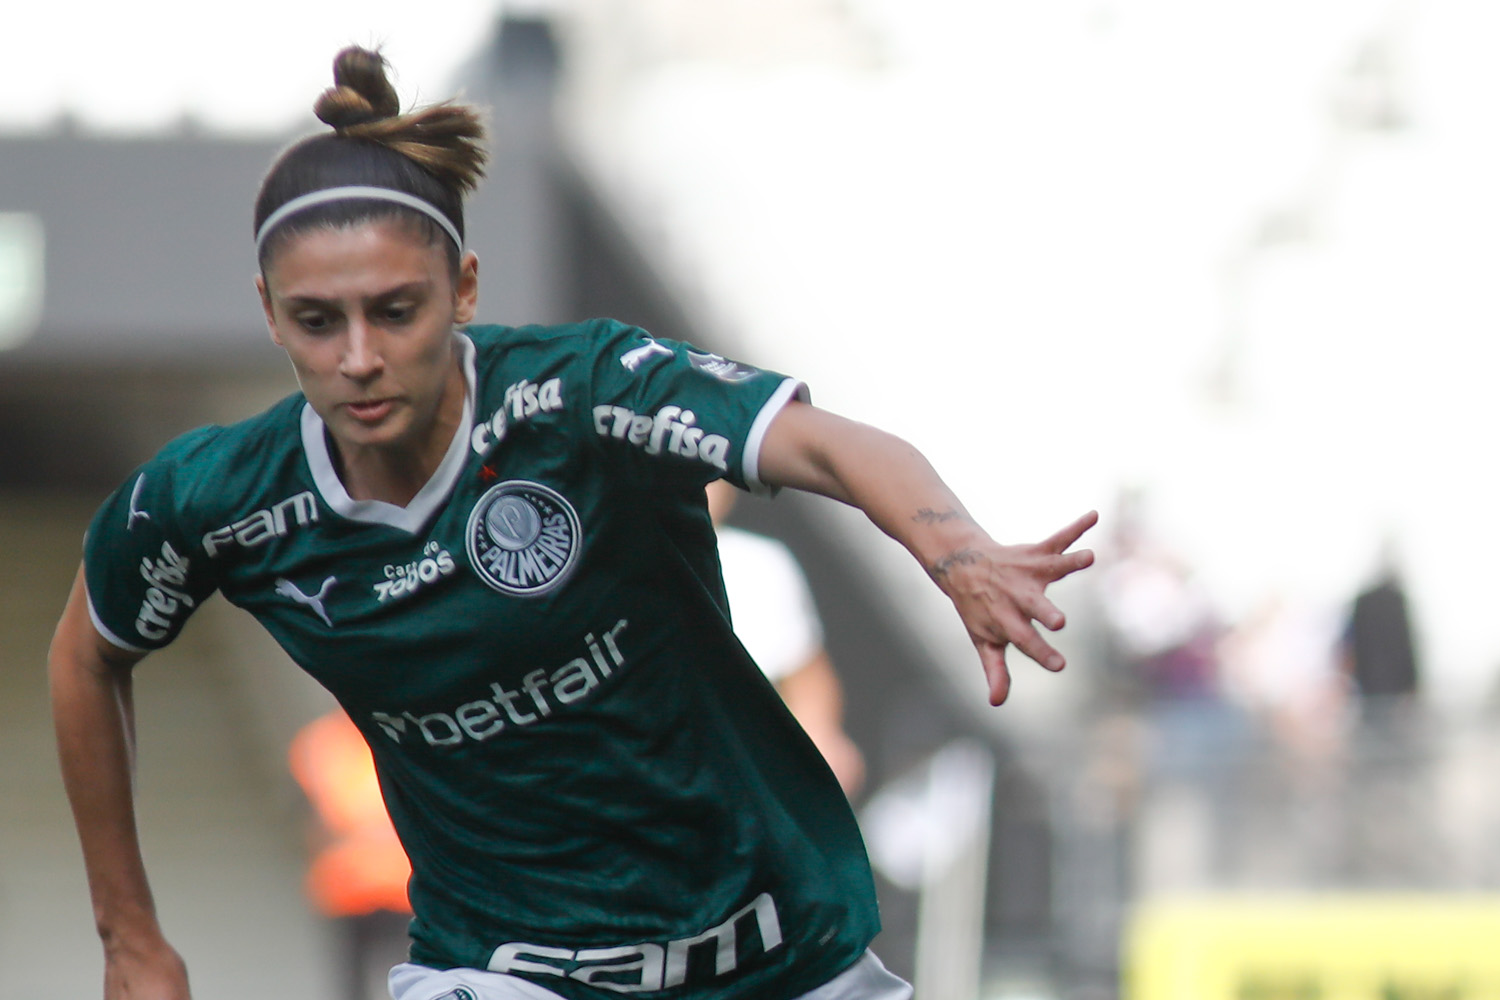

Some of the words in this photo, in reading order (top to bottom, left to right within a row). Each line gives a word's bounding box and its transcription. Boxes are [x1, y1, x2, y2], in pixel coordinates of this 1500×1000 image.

[592, 404, 731, 472] crefisa
[373, 550, 456, 602] TODOS
[424, 540, 440, 557] de
[480, 513, 572, 587] PALMEIRAS
[402, 619, 628, 746] betfair
